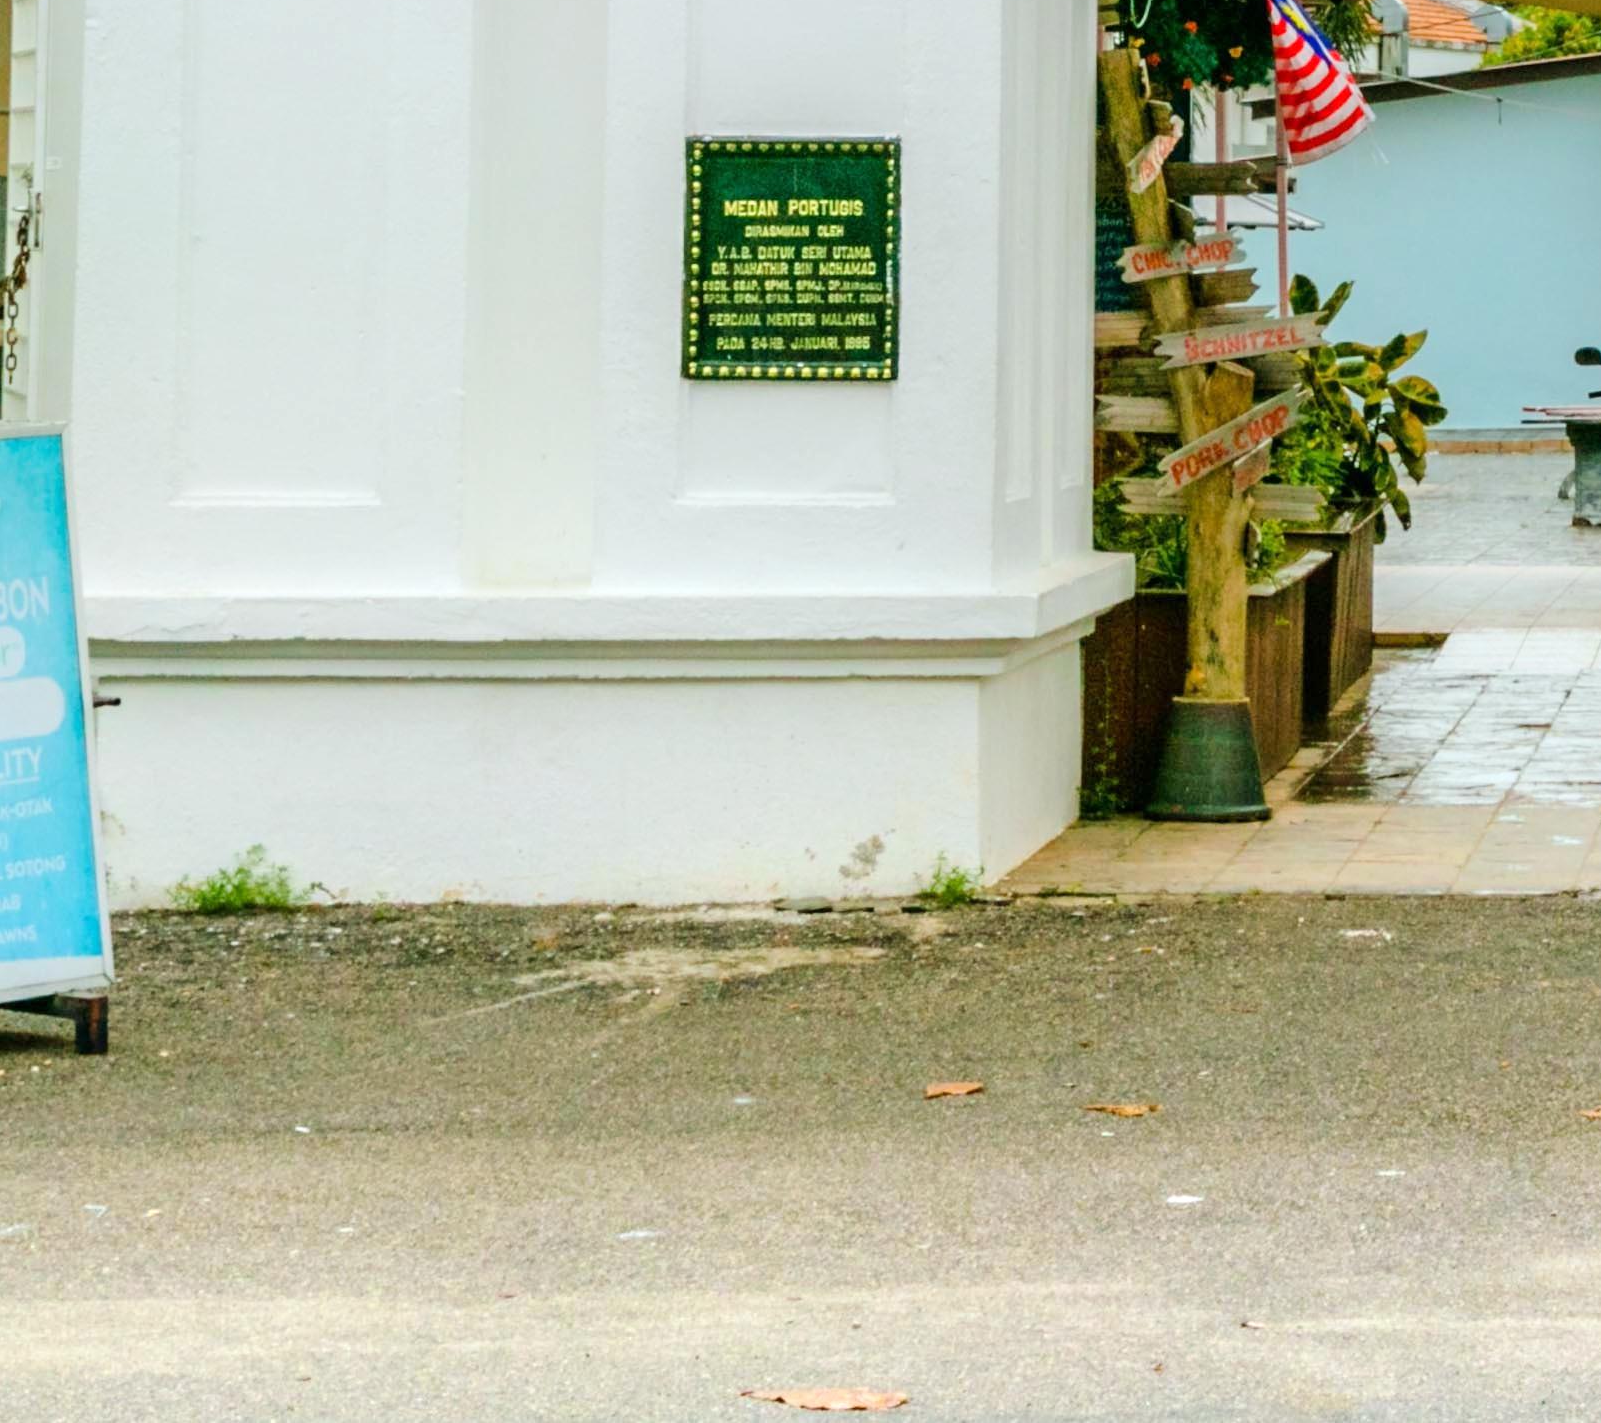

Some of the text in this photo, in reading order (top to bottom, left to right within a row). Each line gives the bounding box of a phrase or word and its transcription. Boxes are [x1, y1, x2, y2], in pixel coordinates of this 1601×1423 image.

[724, 199, 864, 217] MEDAN PORTUGIS
[744, 225, 845, 238] DIRASMIKAN OLEH
[758, 246, 796, 259] DATUK
[801, 246, 827, 259] SERI
[832, 246, 872, 259] UTAMA
[733, 262, 789, 276] MAHATHIR
[794, 262, 813, 276] BIN
[819, 261, 877, 276] MOHAMAD
[708, 313, 877, 326] PERDANA MENTERI MALAYSIA
[716, 337, 745, 350] PADA
[1185, 326, 1305, 361] SCHNITZEL
[1170, 438, 1230, 487] PORK
[1233, 404, 1288, 449] CHOP
[6, 854, 66, 880] SOTONG
